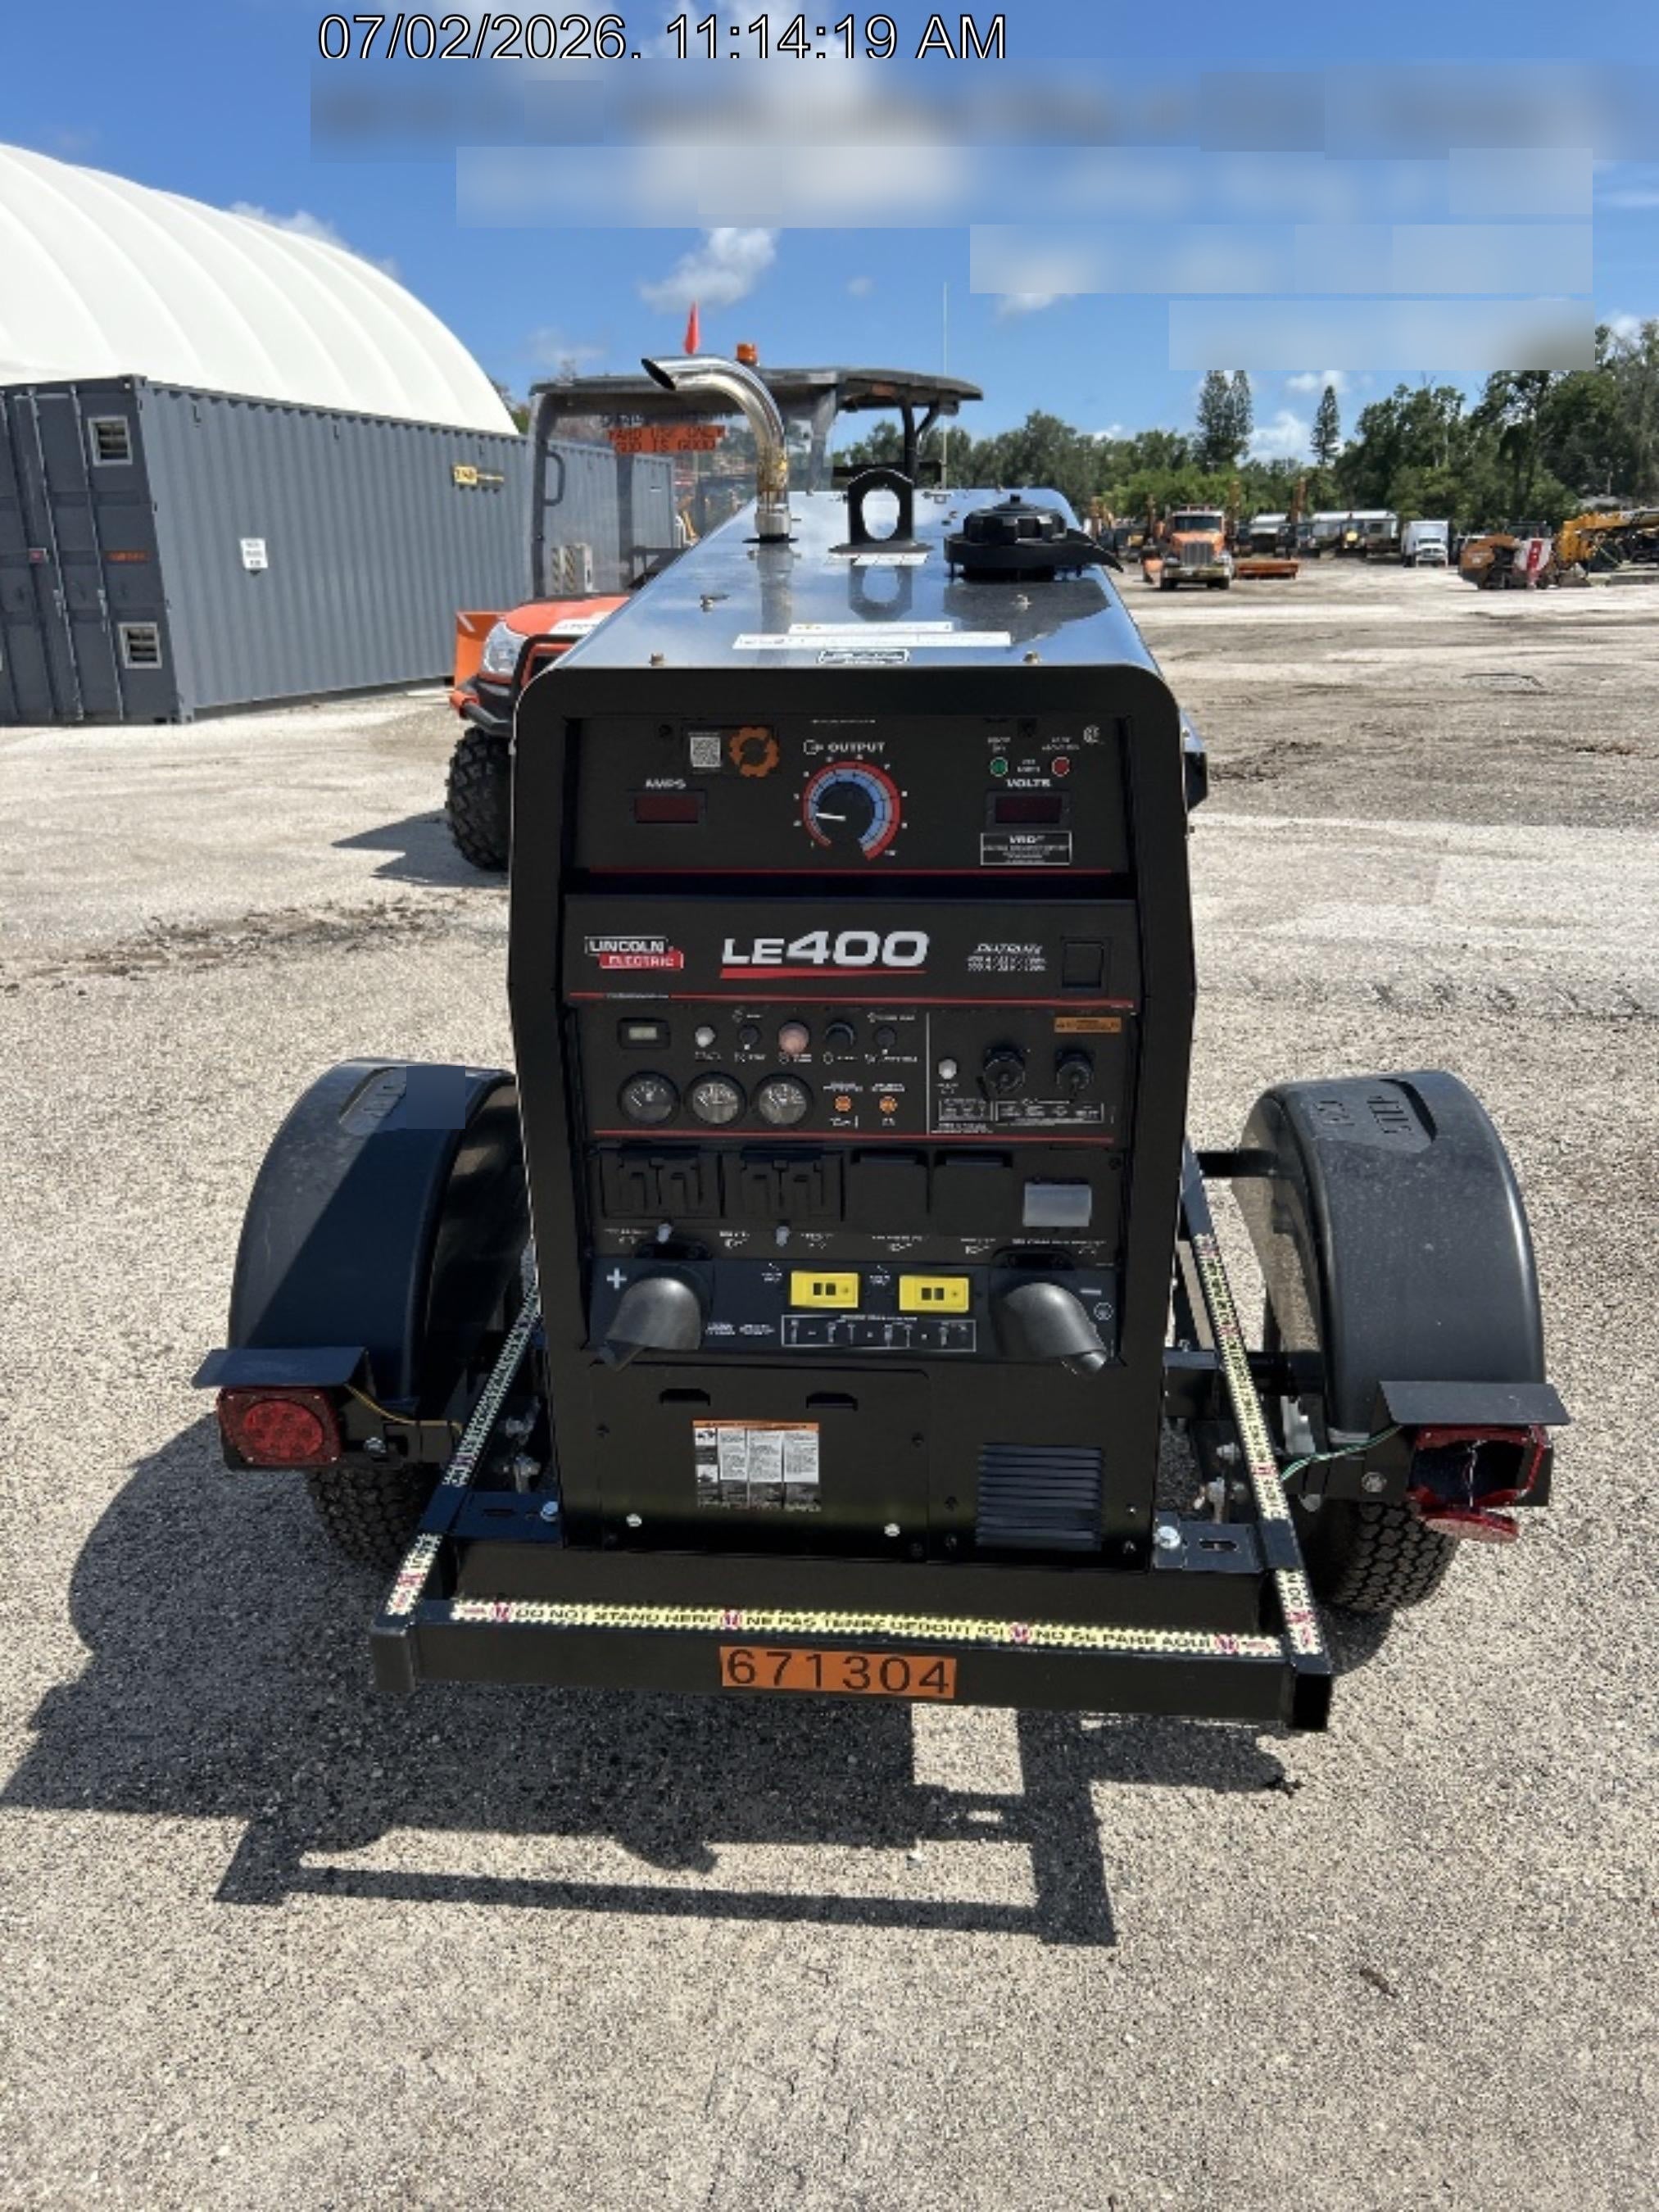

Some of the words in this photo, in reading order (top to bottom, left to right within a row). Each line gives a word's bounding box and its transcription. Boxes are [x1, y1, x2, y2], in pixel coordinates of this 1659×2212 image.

[827, 741, 885, 754] OUTPUT
[645, 778, 686, 790] AMPS
[1005, 777, 1052, 788] VOLTS
[589, 940, 664, 954] LINCOLN
[722, 931, 930, 967] LE400
[607, 954, 674, 968] ELECTRIC
[727, 1648, 950, 1694] 671304
